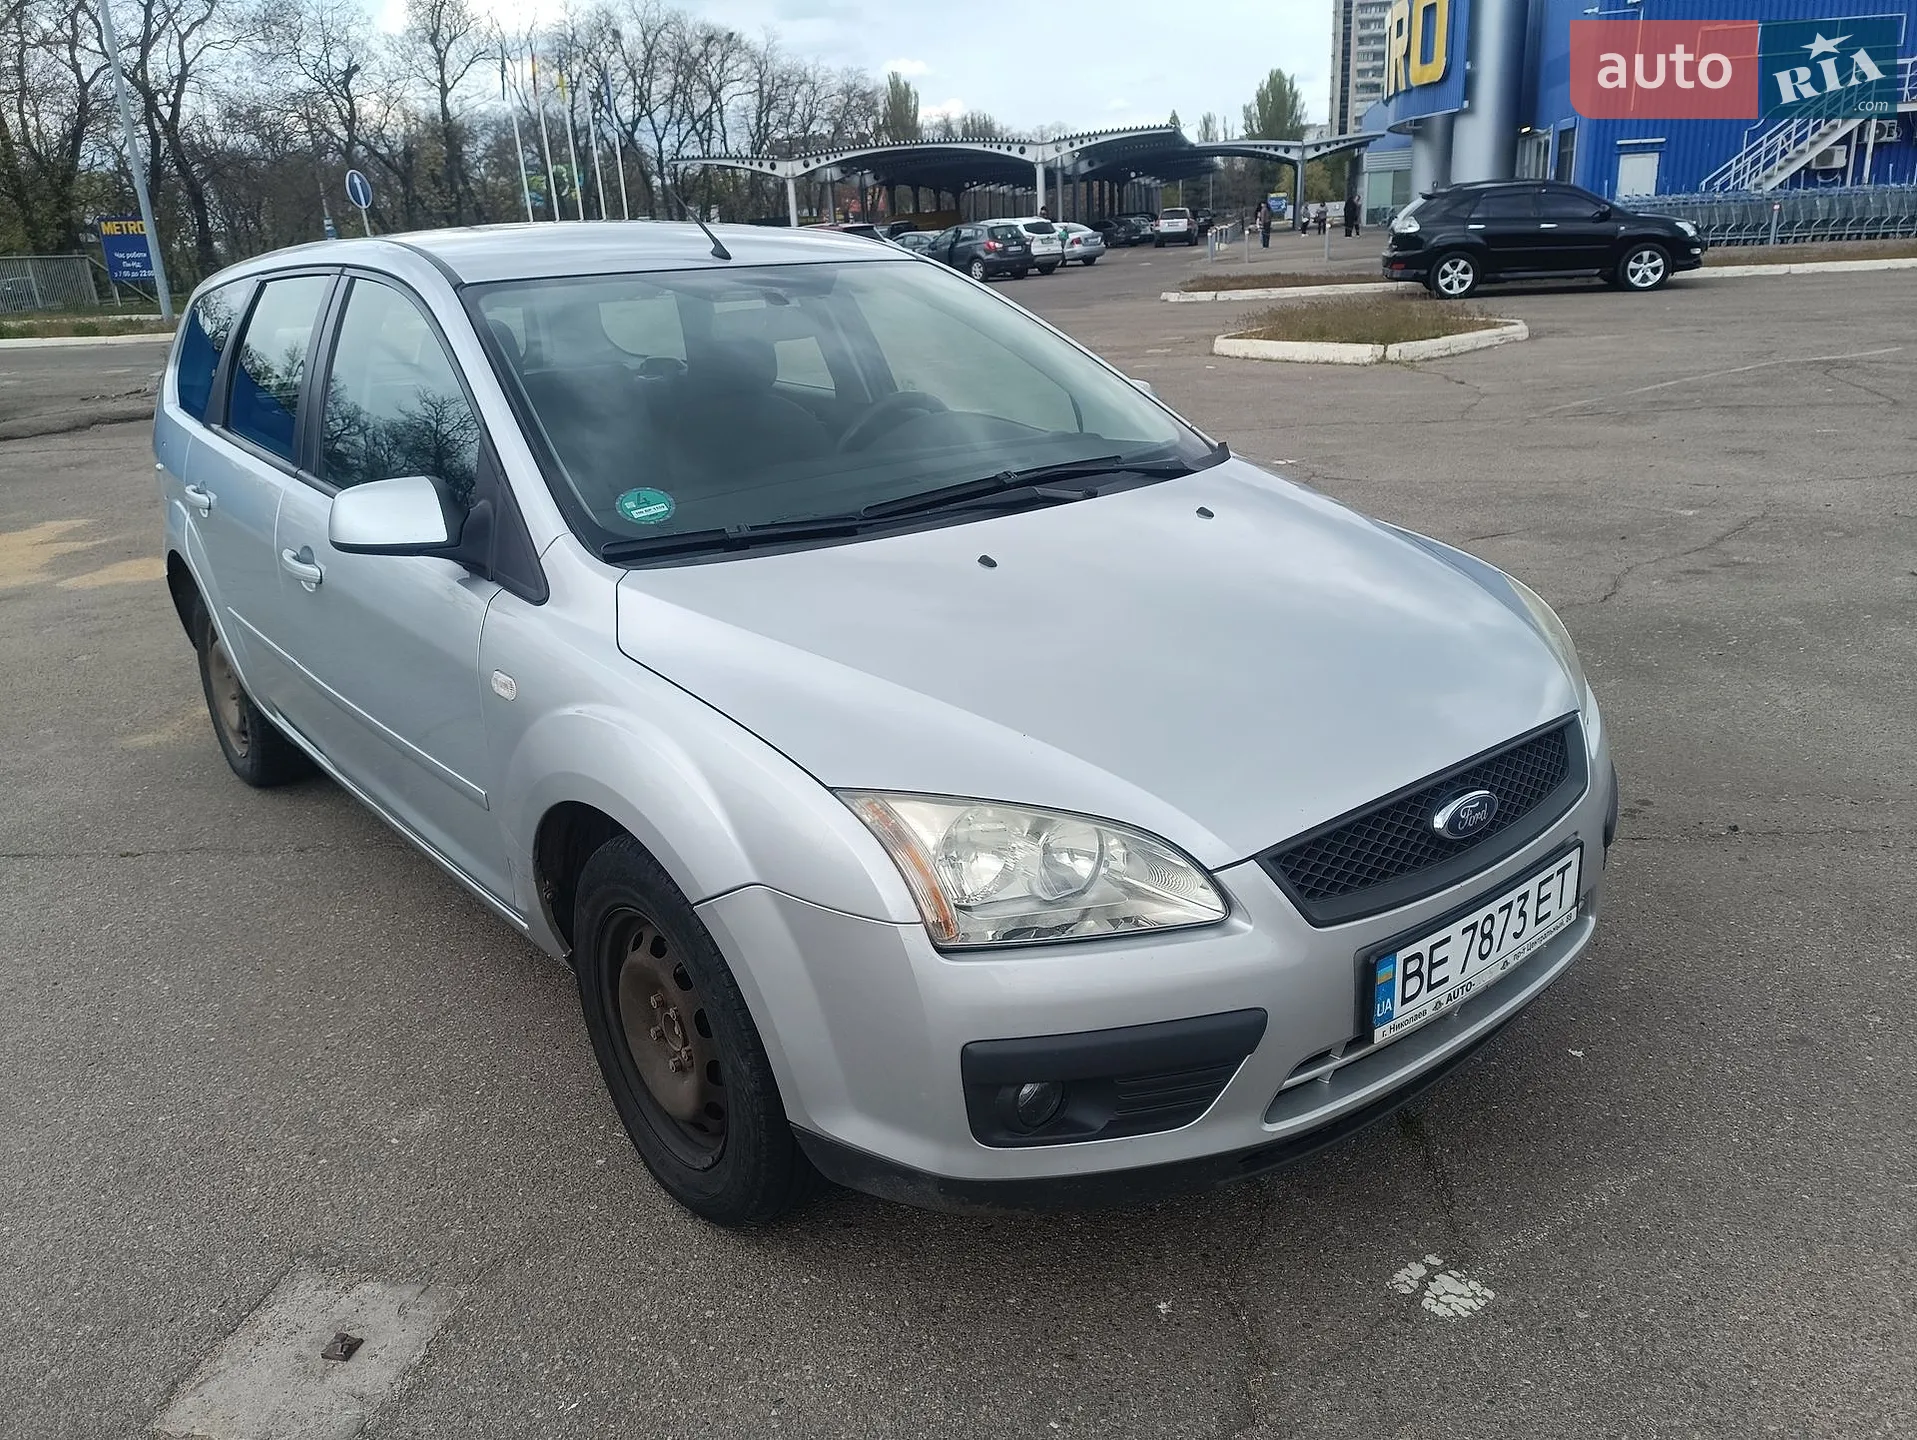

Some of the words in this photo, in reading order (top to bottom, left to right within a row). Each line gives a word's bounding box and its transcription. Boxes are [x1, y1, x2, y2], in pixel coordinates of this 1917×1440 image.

[101, 221, 146, 234] METRO
[1458, 801, 1488, 831] Ford
[1400, 934, 1452, 1007] BE
[1459, 888, 1530, 976] 7873
[1534, 860, 1573, 928] ET
[1376, 998, 1393, 1017] UA
[1389, 1009, 1428, 1035] Николаев
